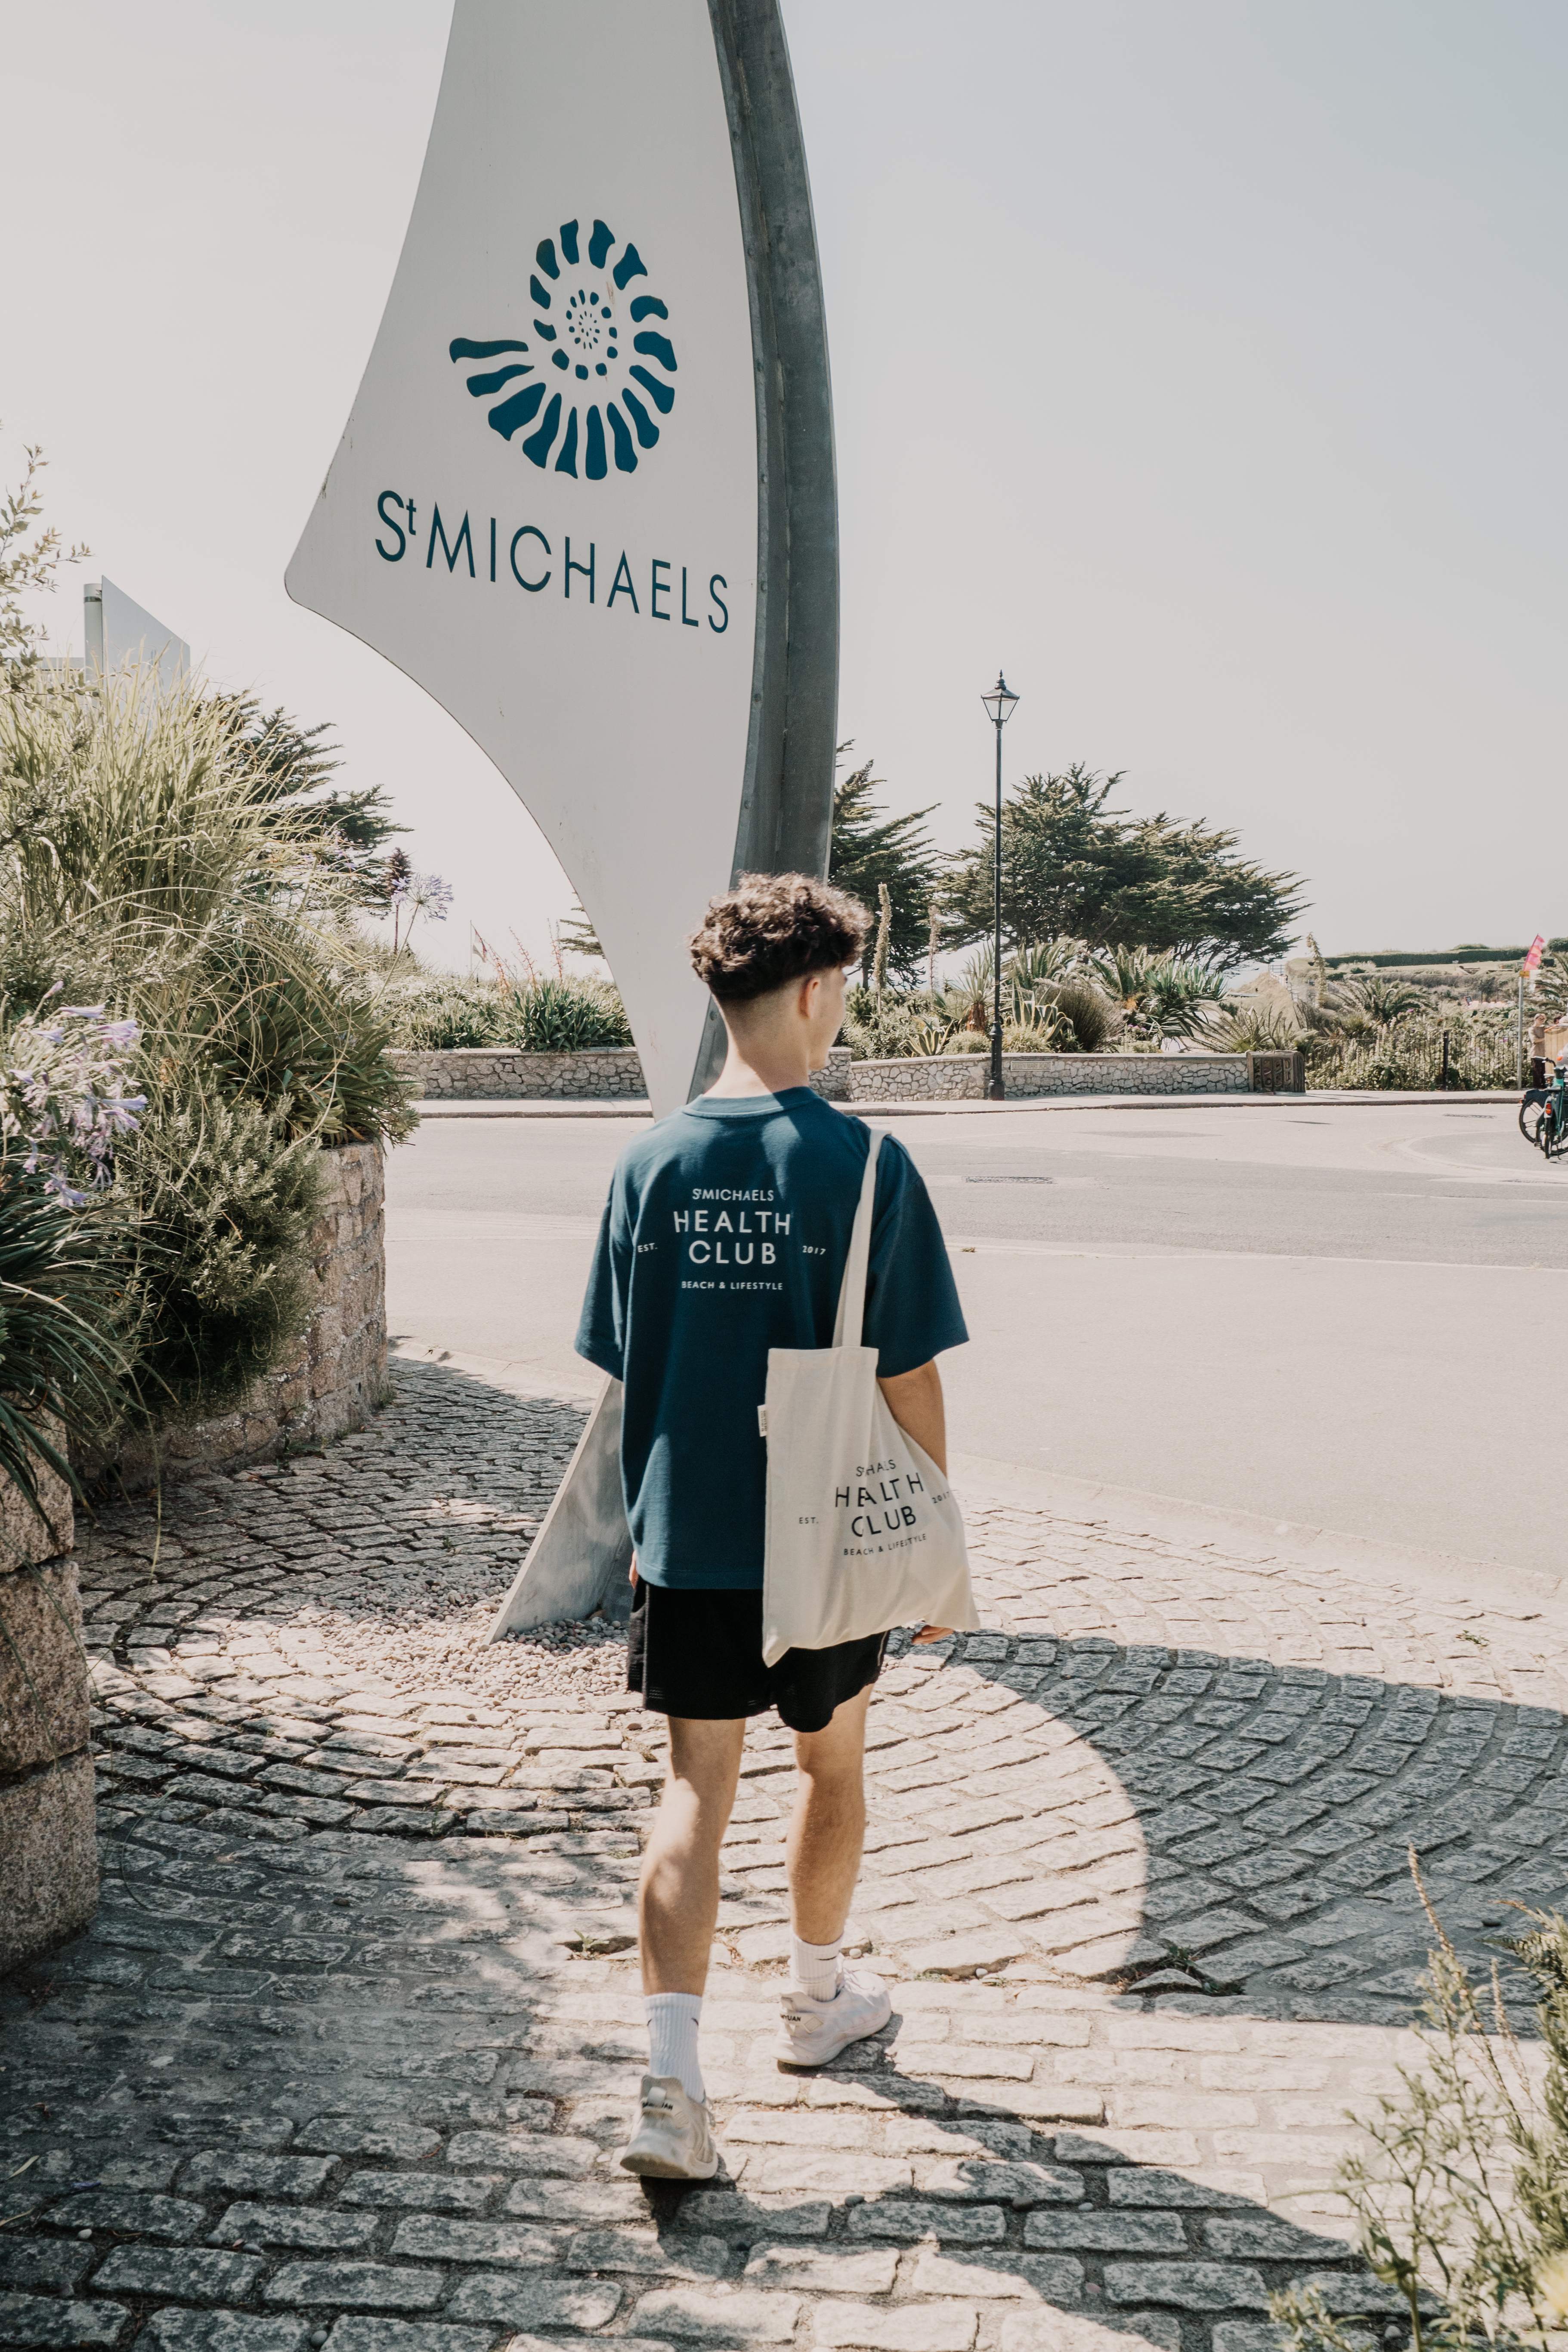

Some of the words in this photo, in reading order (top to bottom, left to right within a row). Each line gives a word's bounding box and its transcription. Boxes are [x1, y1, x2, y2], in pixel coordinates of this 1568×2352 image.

[673, 1210, 791, 1235] HEALTH
[637, 1242, 658, 1253] EST.
[689, 1240, 776, 1264] CLUB
[802, 1245, 826, 1255] 2017
[681, 1281, 715, 1289] BEACH
[730, 1282, 783, 1290] LIFESTYLE
[851, 1505, 917, 1538] CLUB
[843, 1548, 874, 1556] BEACH
[888, 1533, 927, 1551] LIFESTYLE
